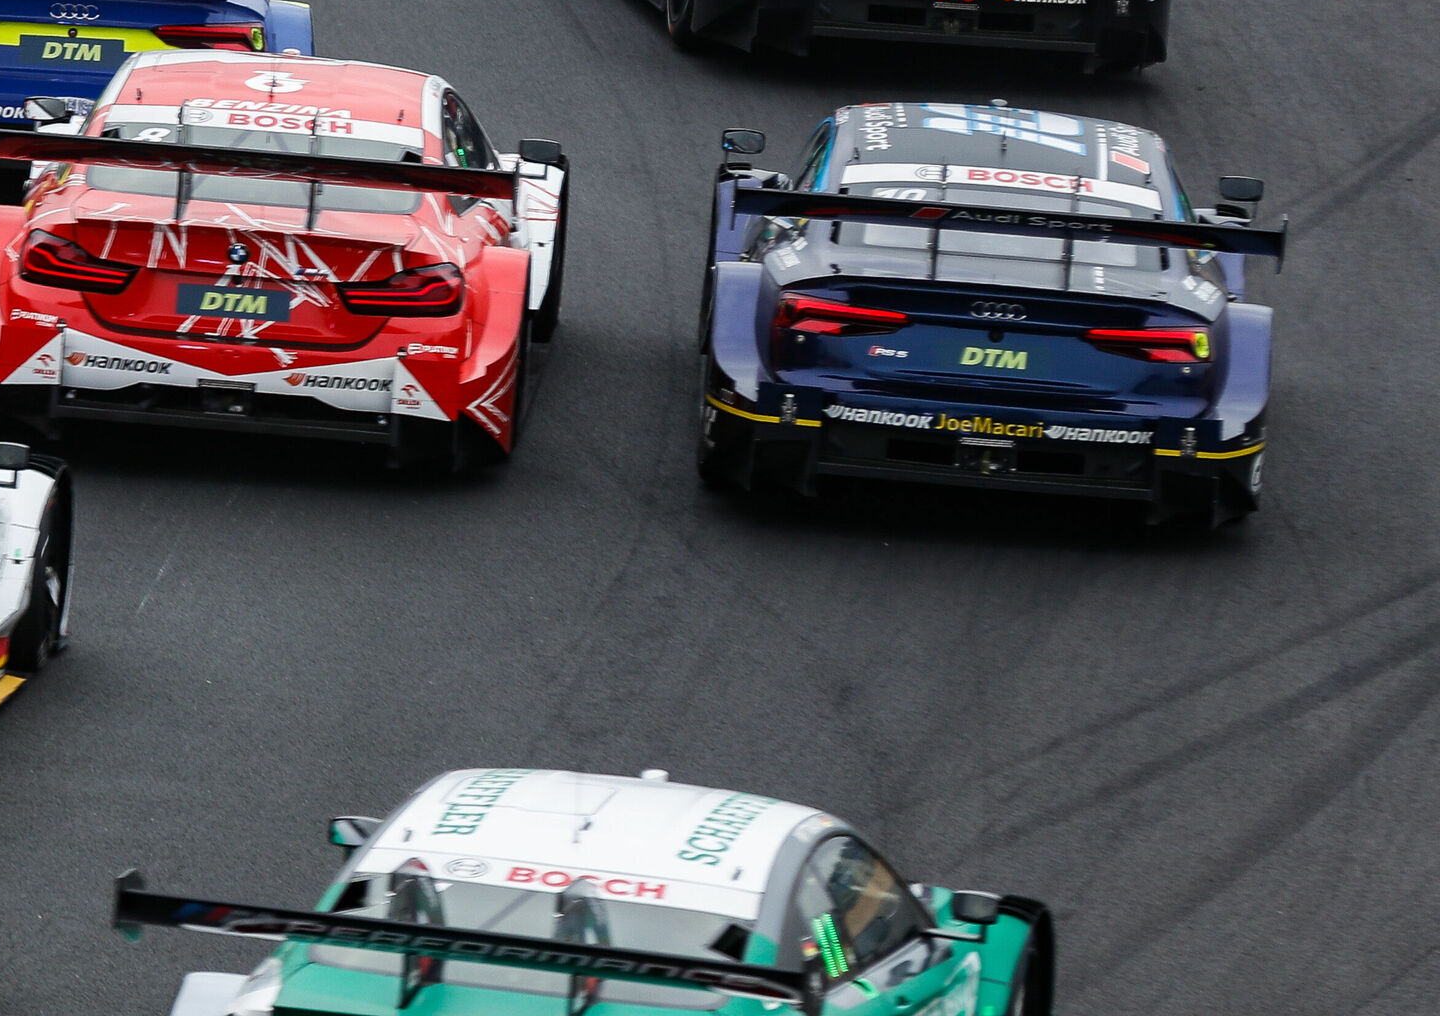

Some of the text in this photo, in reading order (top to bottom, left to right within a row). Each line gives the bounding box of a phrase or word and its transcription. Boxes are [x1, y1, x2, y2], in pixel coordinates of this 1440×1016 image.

[41, 41, 103, 62] DTM
[188, 98, 353, 119] BENZINA
[228, 112, 353, 135] BOSCH
[859, 121, 893, 151] Sport
[967, 169, 1094, 193] BOSCH
[951, 210, 1113, 233] Audi Sport
[199, 291, 268, 315] DTM
[959, 346, 1029, 370] DTM
[934, 412, 1045, 439] JoeMacari
[281, 919, 768, 986] PERFORMANCE
